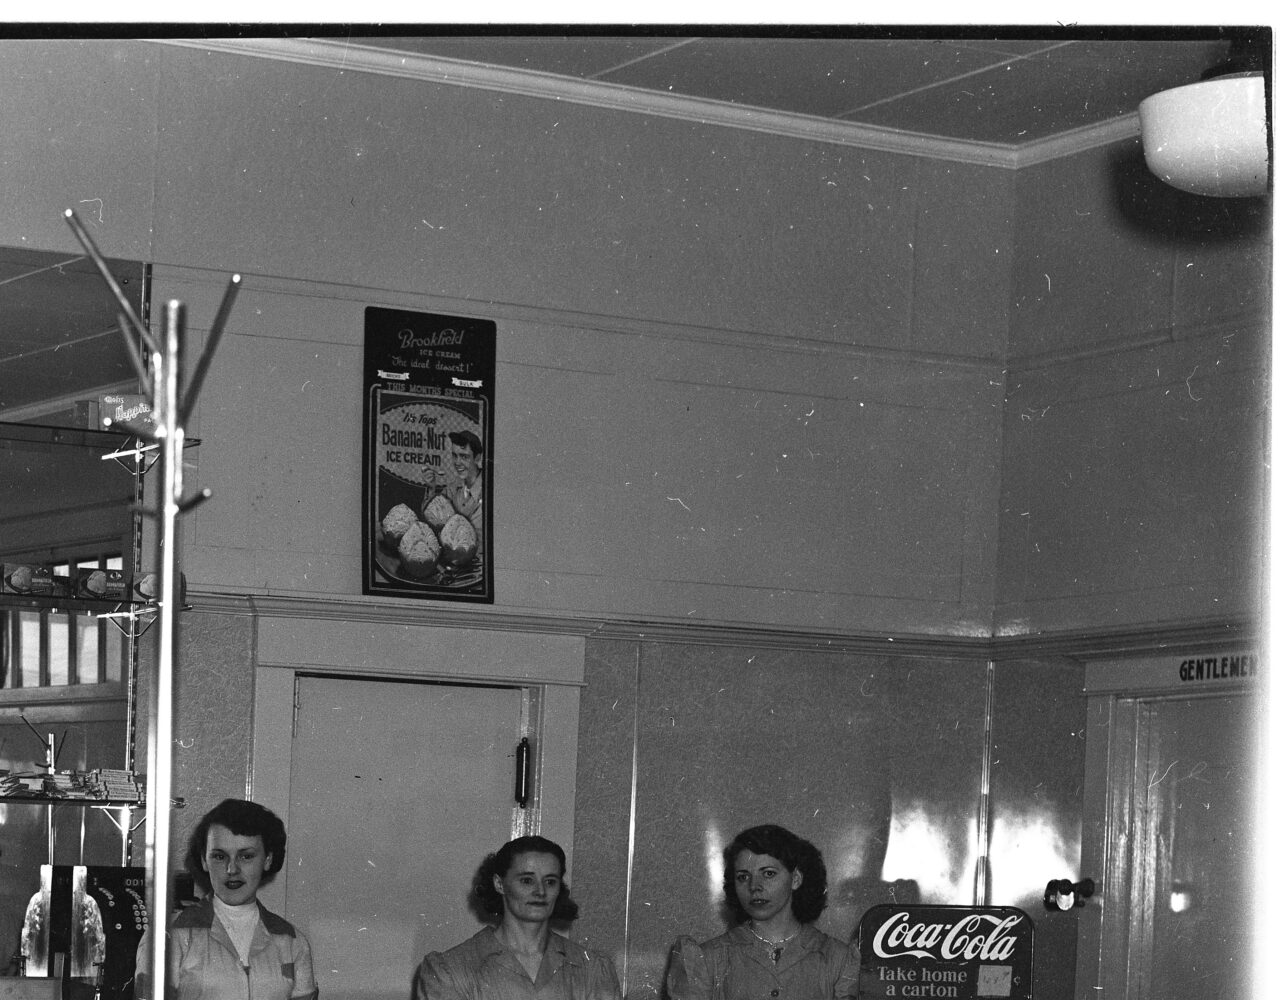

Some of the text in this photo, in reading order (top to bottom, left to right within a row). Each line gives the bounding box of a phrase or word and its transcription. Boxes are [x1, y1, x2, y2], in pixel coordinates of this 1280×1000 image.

[398, 328, 465, 349] Brookfield
[436, 350, 461, 359] CREAM
[410, 357, 430, 370] ideal
[387, 382, 406, 392] THIS
[444, 388, 475, 398] SPECIAL
[419, 413, 438, 425] Tops
[386, 451, 442, 467] ICE CREAM
[873, 911, 1024, 961] Coca-Cola
[877, 966, 917, 982] Take
[921, 967, 968, 984] home
[886, 982, 958, 998] a carton
